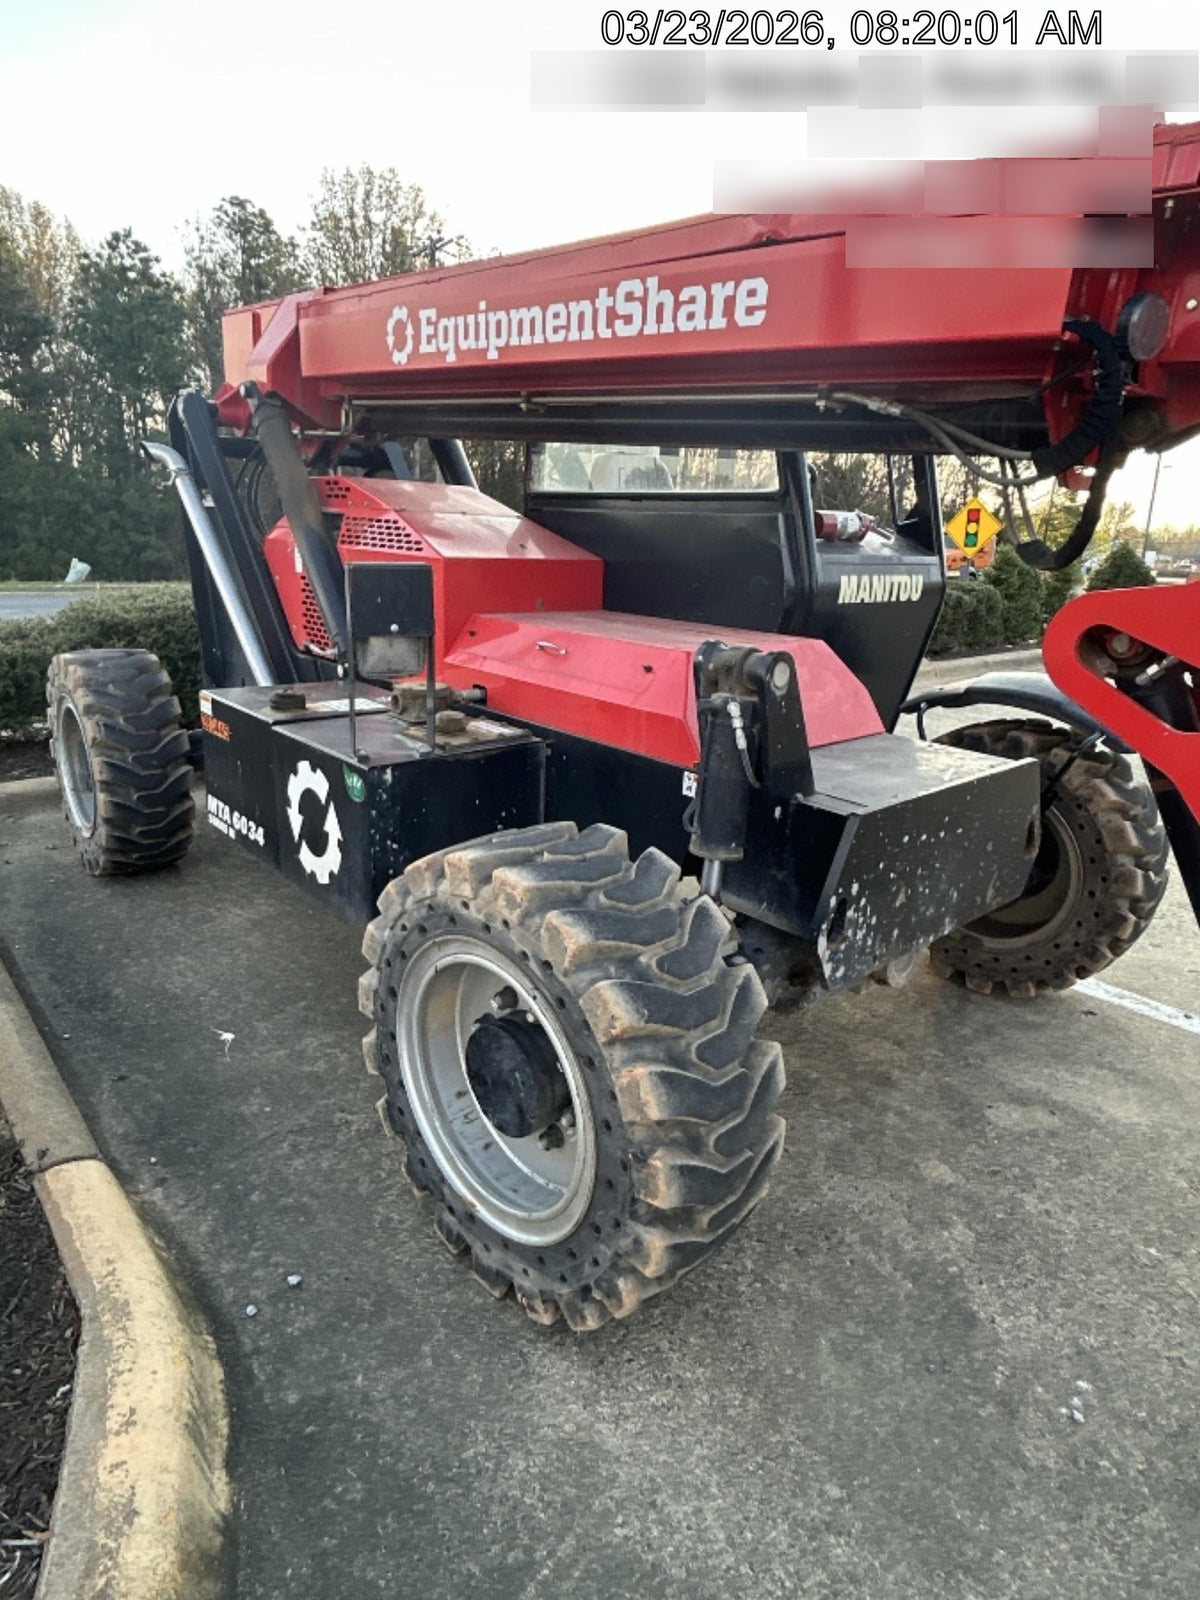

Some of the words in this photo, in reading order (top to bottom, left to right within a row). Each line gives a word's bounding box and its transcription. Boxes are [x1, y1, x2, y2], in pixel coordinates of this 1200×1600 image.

[418, 276, 769, 363] EquipmentShare
[837, 573, 924, 605] MANITOU
[207, 793, 232, 826] MTA
[232, 810, 266, 847] 6034
